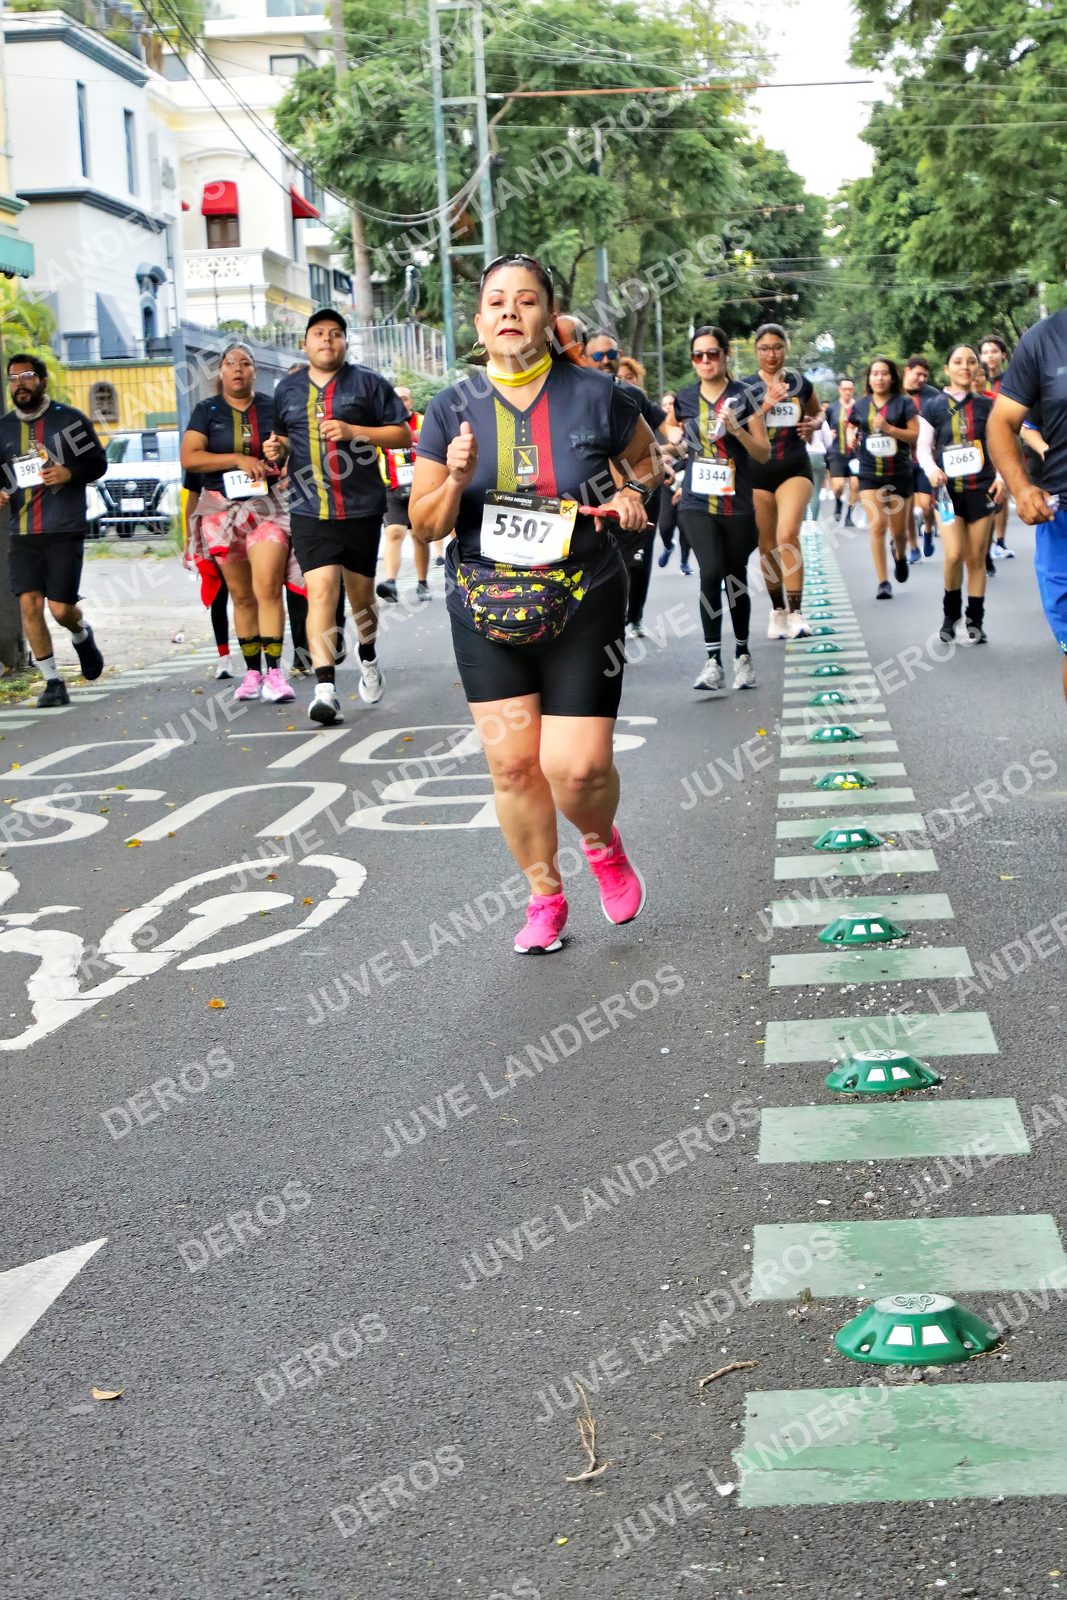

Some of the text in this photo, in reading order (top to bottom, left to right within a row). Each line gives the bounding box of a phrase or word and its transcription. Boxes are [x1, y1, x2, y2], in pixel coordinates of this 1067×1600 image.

[949, 451, 975, 466] 2665
[19, 462, 41, 477] 3981
[698, 468, 727, 481] 3344
[492, 513, 554, 544] 5507
